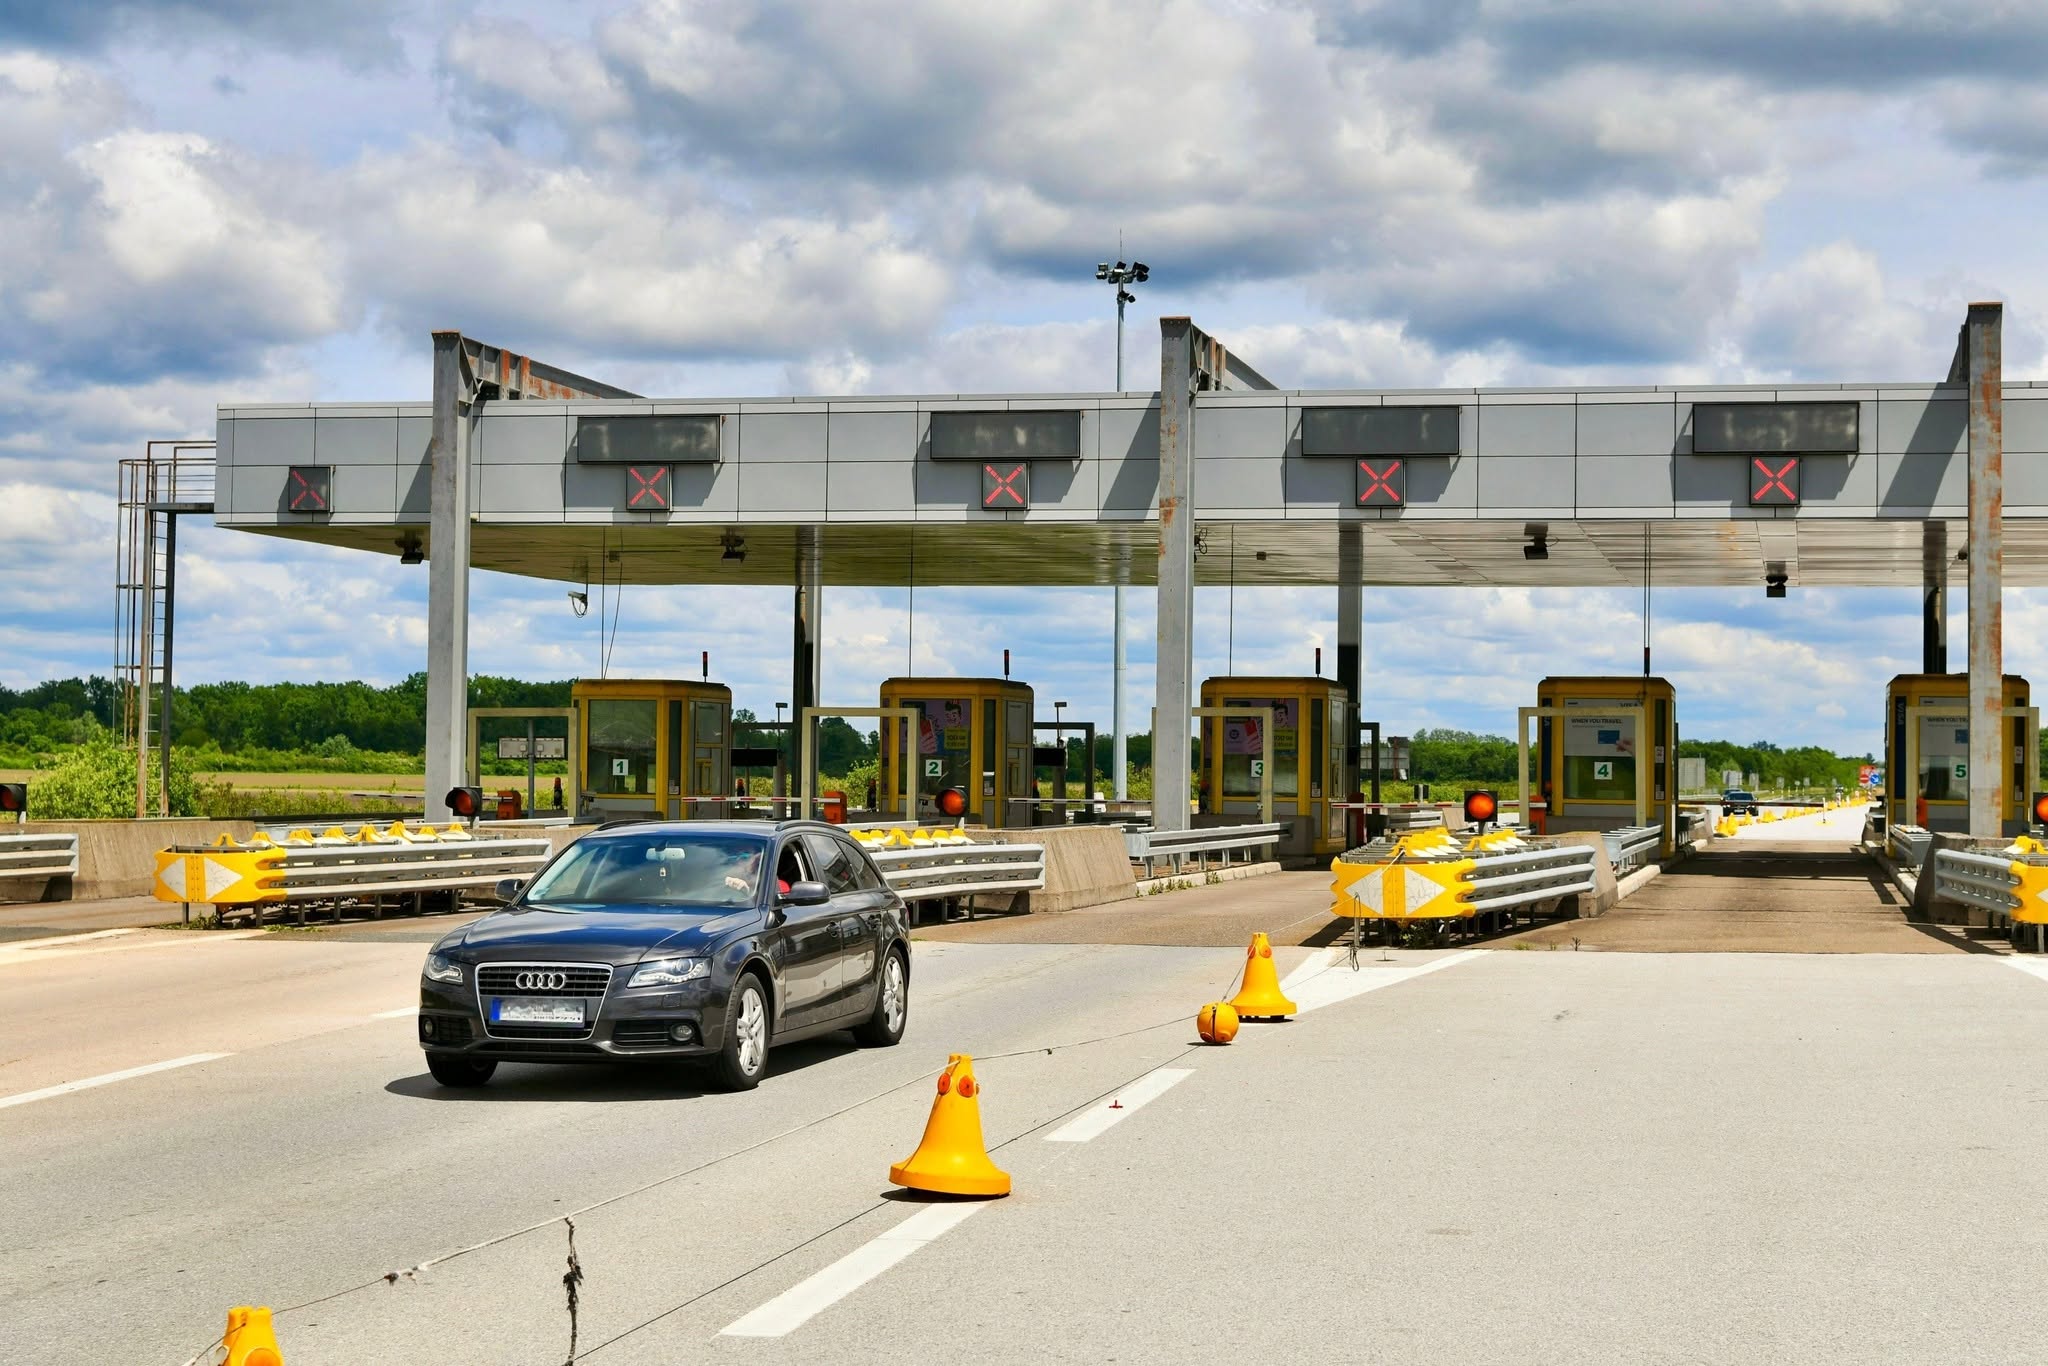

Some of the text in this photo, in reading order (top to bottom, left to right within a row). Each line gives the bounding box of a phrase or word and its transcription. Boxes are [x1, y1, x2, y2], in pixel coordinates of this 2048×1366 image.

[616, 760, 624, 774] 1
[928, 761, 939, 775] 2
[1254, 762, 1264, 776] 3
[1597, 764, 1609, 778] 4
[1955, 764, 1967, 778] 5
